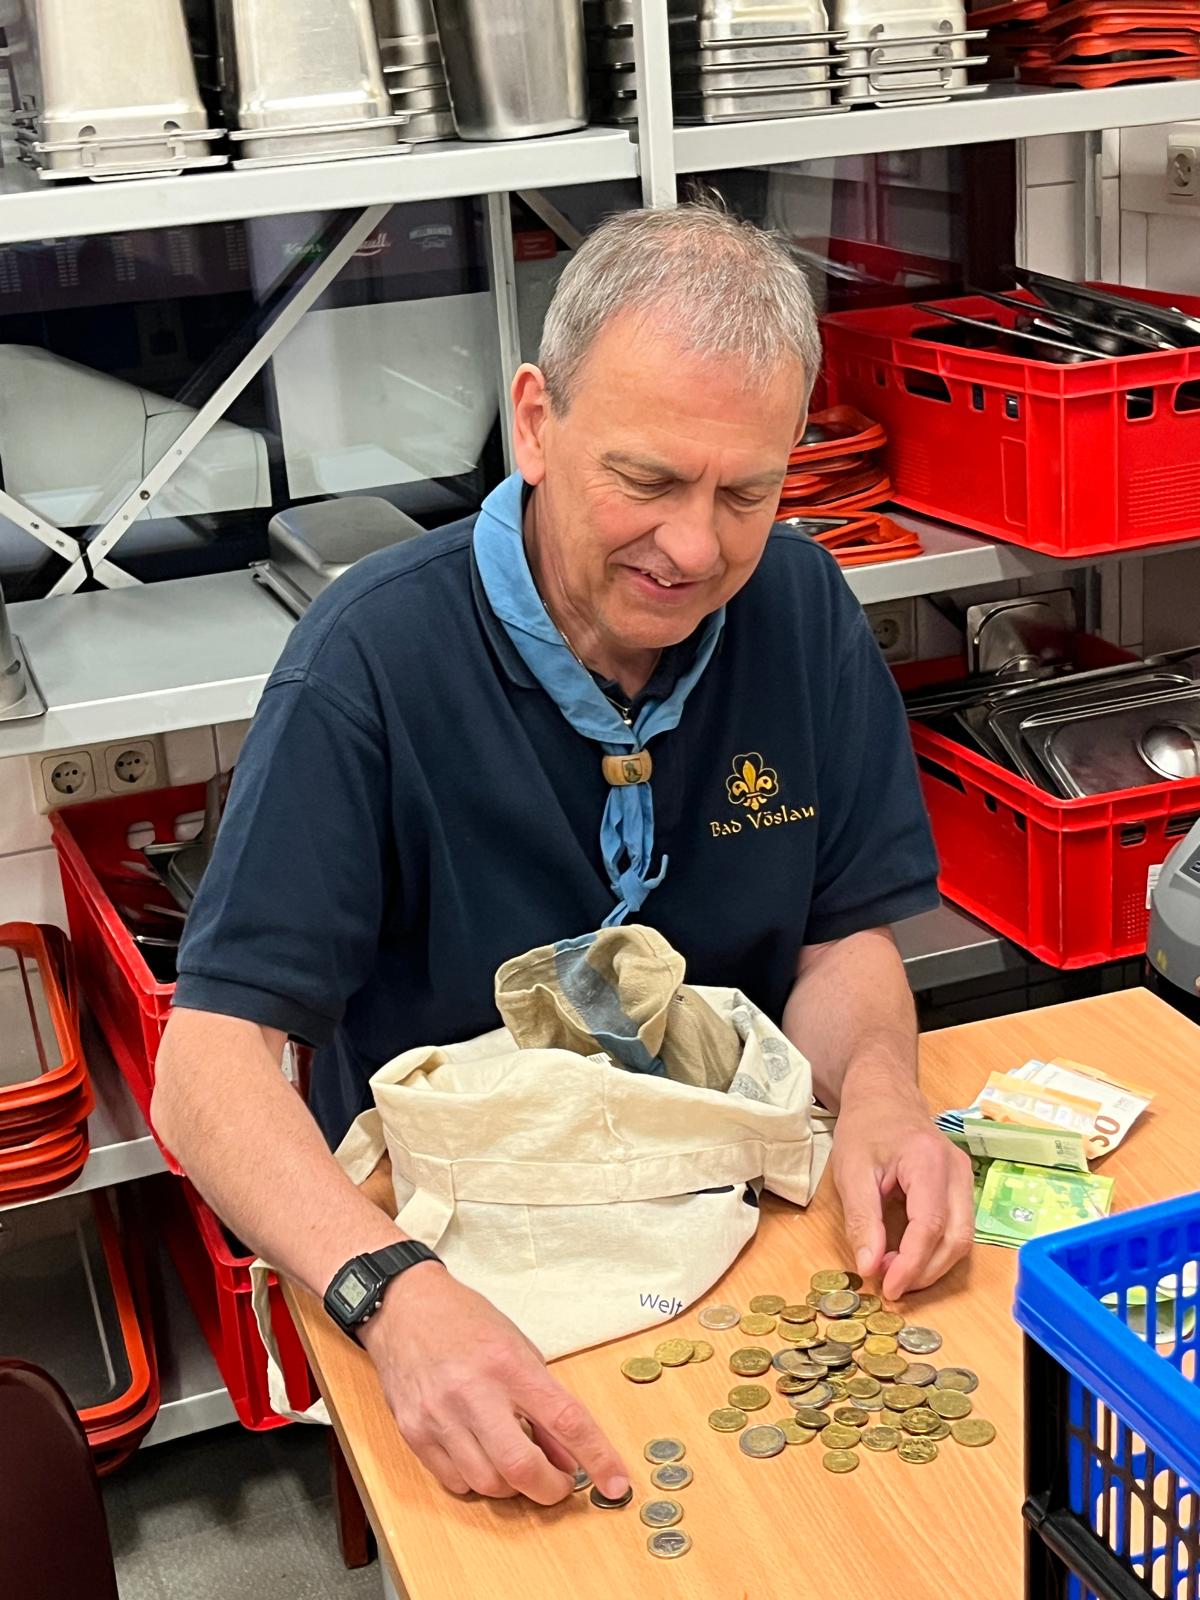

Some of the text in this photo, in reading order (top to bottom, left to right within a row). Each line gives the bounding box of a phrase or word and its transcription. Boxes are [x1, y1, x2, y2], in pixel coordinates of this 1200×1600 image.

[709, 804, 816, 838] Bad Vöslau
[639, 1293, 683, 1317] Welt
